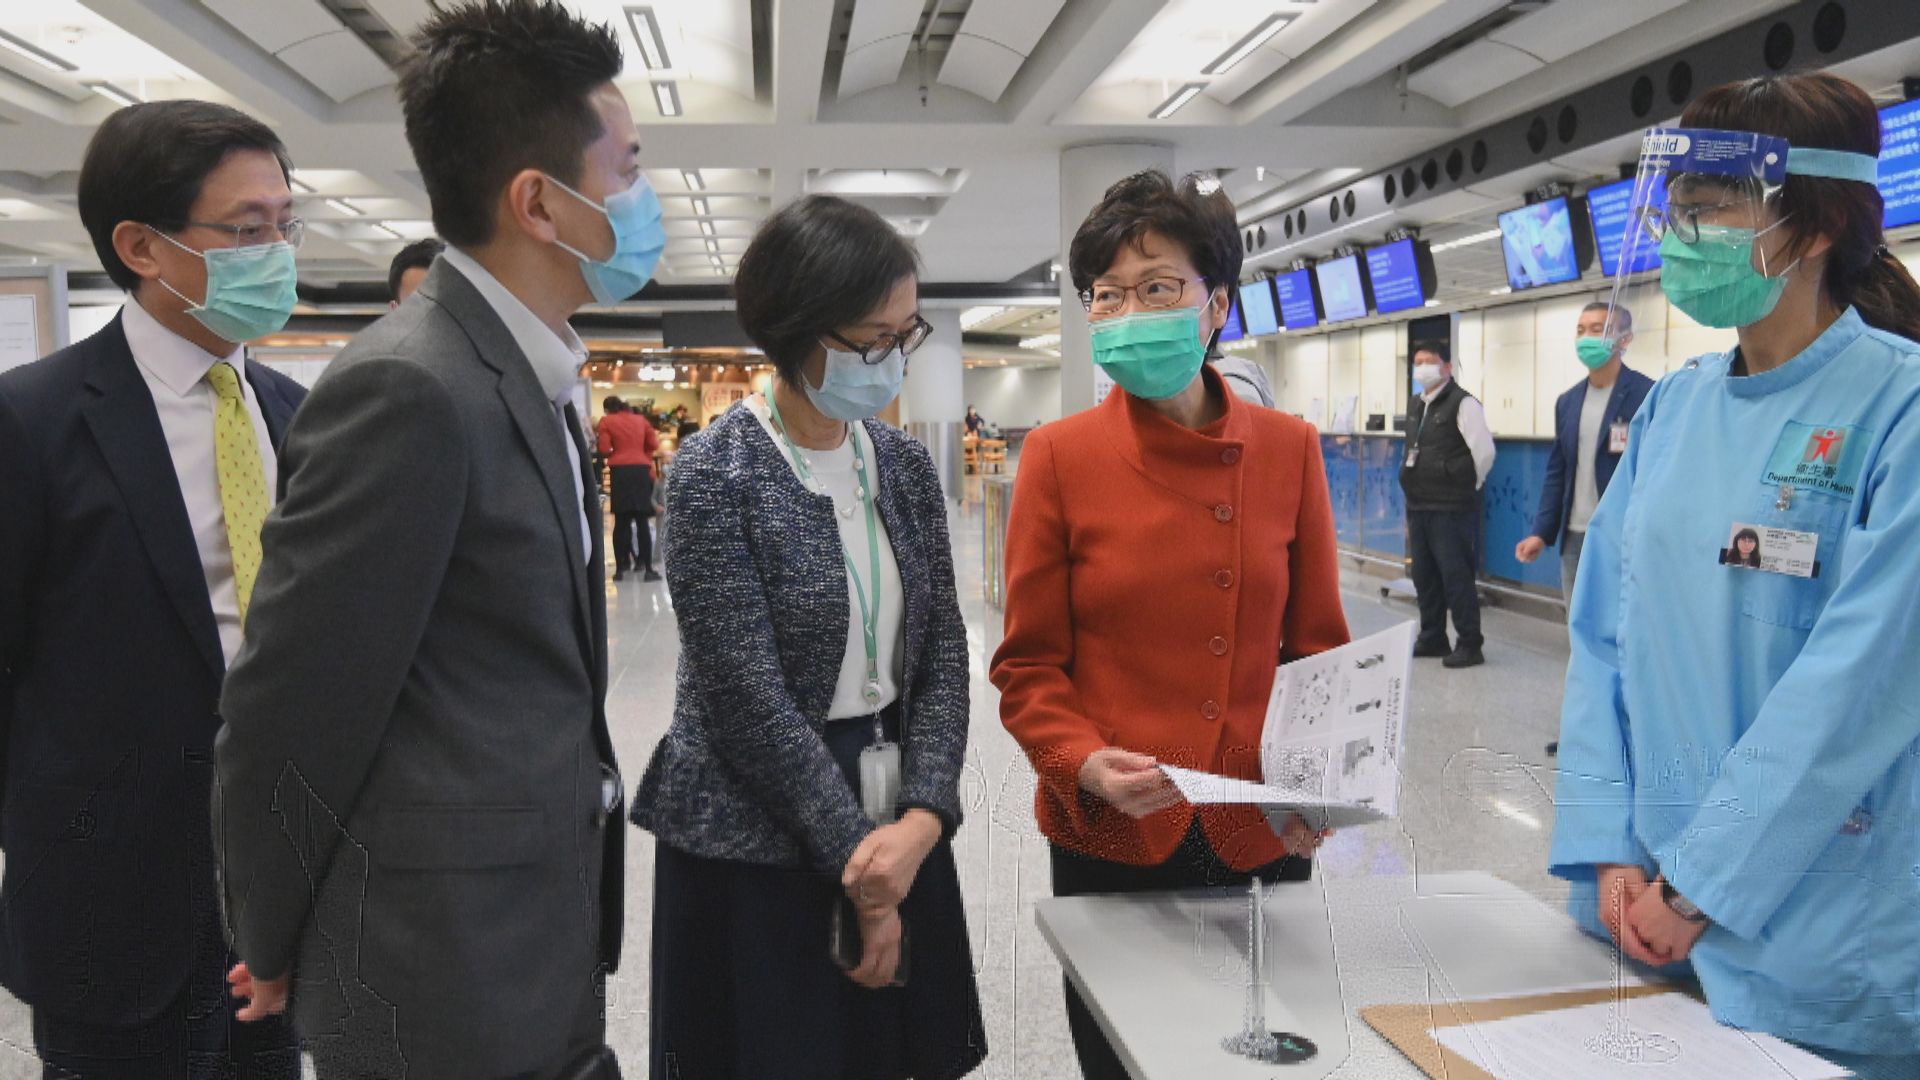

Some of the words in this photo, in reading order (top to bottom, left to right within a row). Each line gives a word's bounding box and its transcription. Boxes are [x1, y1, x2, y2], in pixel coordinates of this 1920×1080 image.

[1767, 472, 1817, 486] Department
[1818, 480, 1829, 488] of
[1830, 482, 1854, 495] Health
